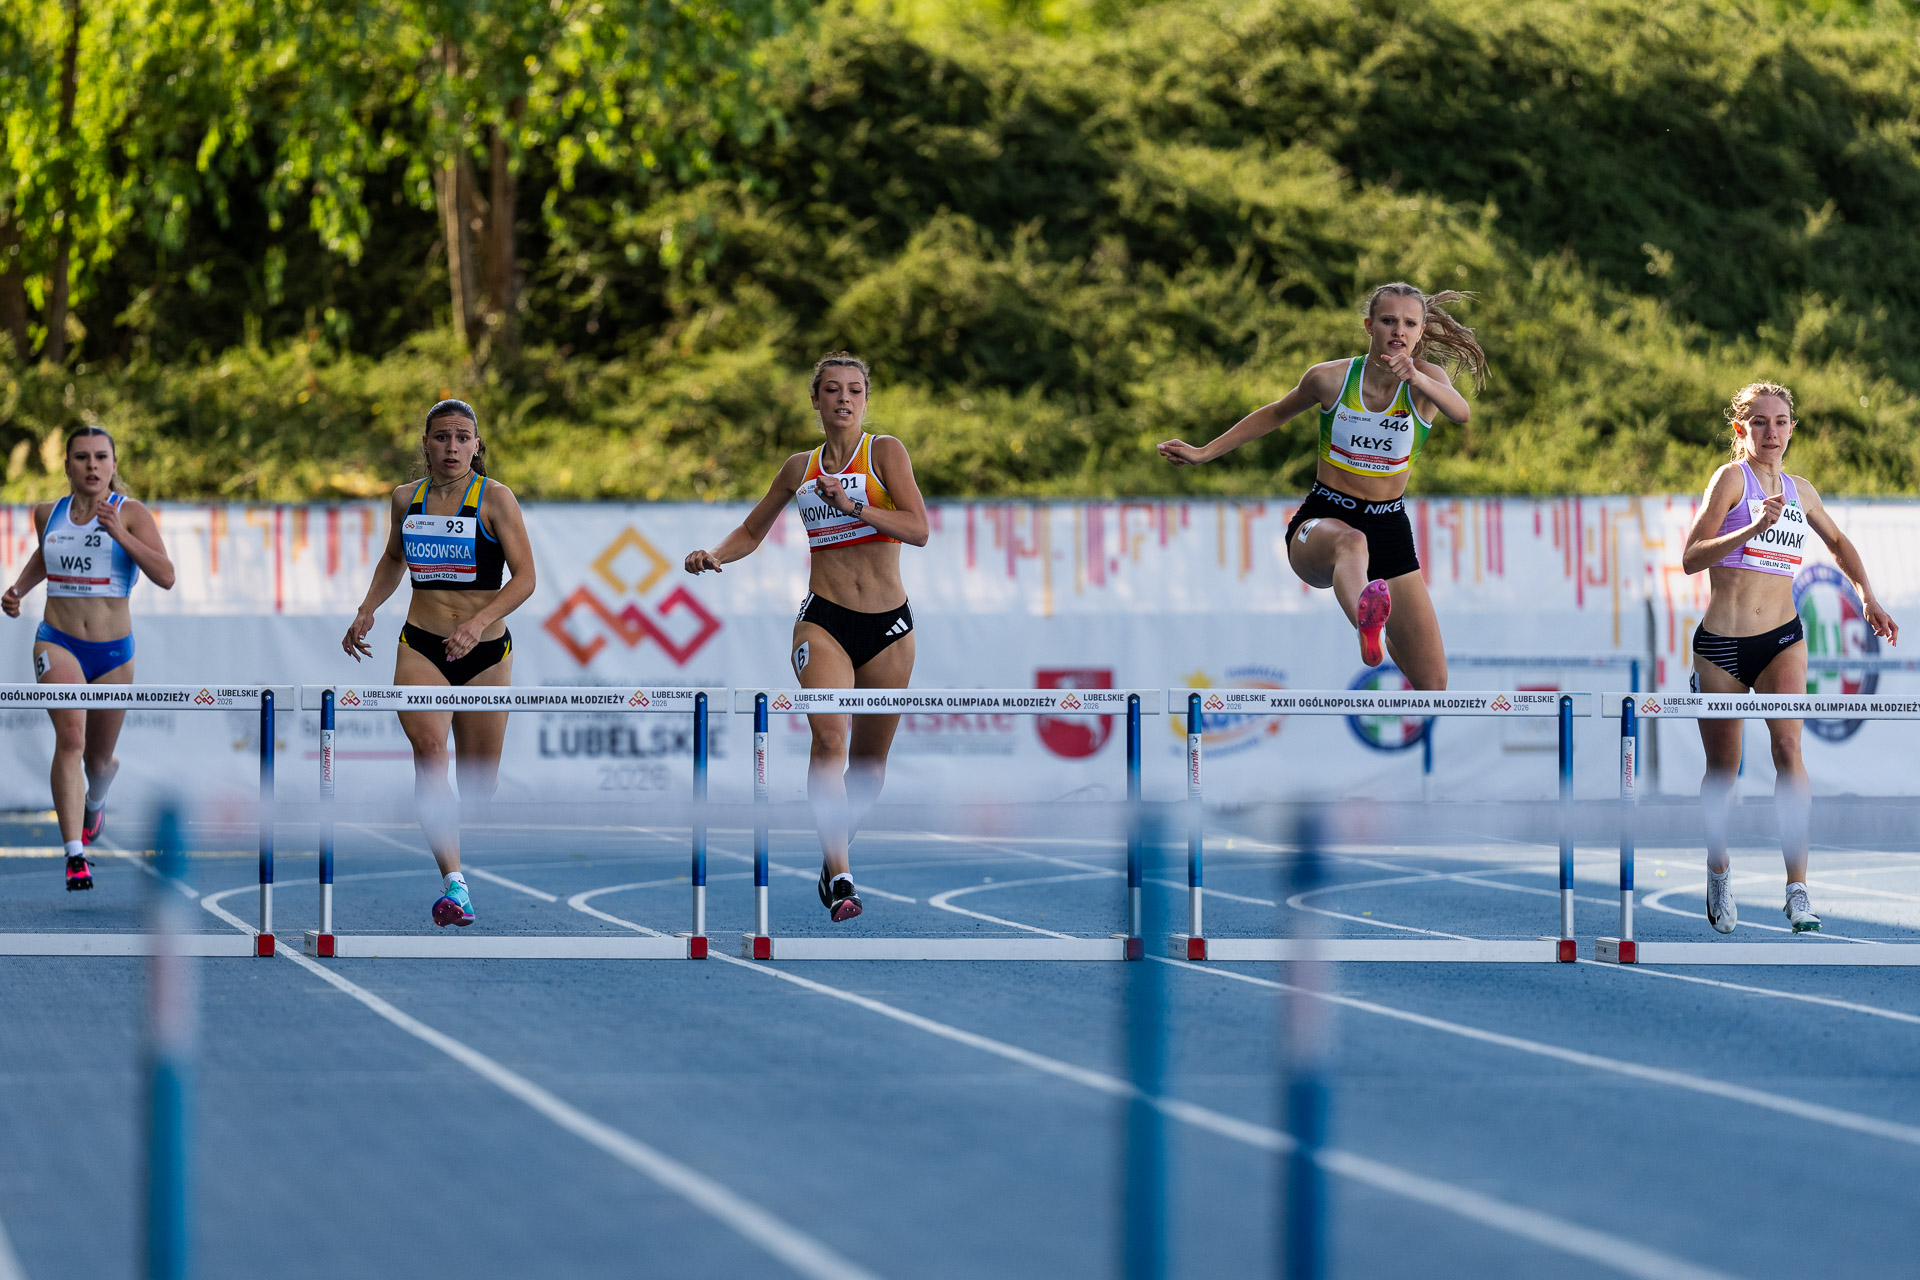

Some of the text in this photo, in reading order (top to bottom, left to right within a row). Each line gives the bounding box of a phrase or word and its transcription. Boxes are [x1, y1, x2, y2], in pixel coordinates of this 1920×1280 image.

[1379, 419, 1408, 432] 446
[1350, 435, 1392, 452] KŁYŚ
[1347, 460, 1370, 469] LUBLIN
[1316, 487, 1402, 514] PRO NIKE
[1784, 508, 1802, 524] 463
[446, 520, 464, 534] 93
[84, 535, 101, 547] 23
[818, 531, 856, 544] LUBLIN 2026
[406, 541, 472, 560] KŁOSOWSKA
[60, 556, 92, 573] WĄS
[798, 648, 805, 670] 6
[1, 690, 190, 702] OGÓLNOPOLSKA OLIMPIADA MŁODZIEŻY
[362, 690, 403, 698] LUBELSKIE
[407, 693, 624, 704] XXXII OGÓLNOPOLSKA OLIMPIADA MŁODZIEŻY
[652, 690, 692, 698] LUBELSKIE
[1083, 694, 1124, 702] LUBELSKIE
[1514, 695, 1554, 703] LUBELSKIE
[838, 696, 1056, 706] XXXII OGÓLNOPOLSKA OLIMPIADA MŁODZIEŻY
[1270, 696, 1487, 708] XXXII OGÓLNOPOLSKA OLIMPIADA MŁODZIEŻY
[1663, 698, 1702, 706] LUBELSKIE
[1707, 702, 1732, 711] XXXII
[1736, 700, 1812, 712] OGÓLNOPOLSKA
[1814, 702, 1868, 712] OLIMPIADA
[539, 726, 726, 758] LUBELSKE
[323, 746, 332, 782] polanik
[756, 748, 766, 784] polanik
[1191, 748, 1200, 784] polanik
[1624, 752, 1633, 788] polanik
